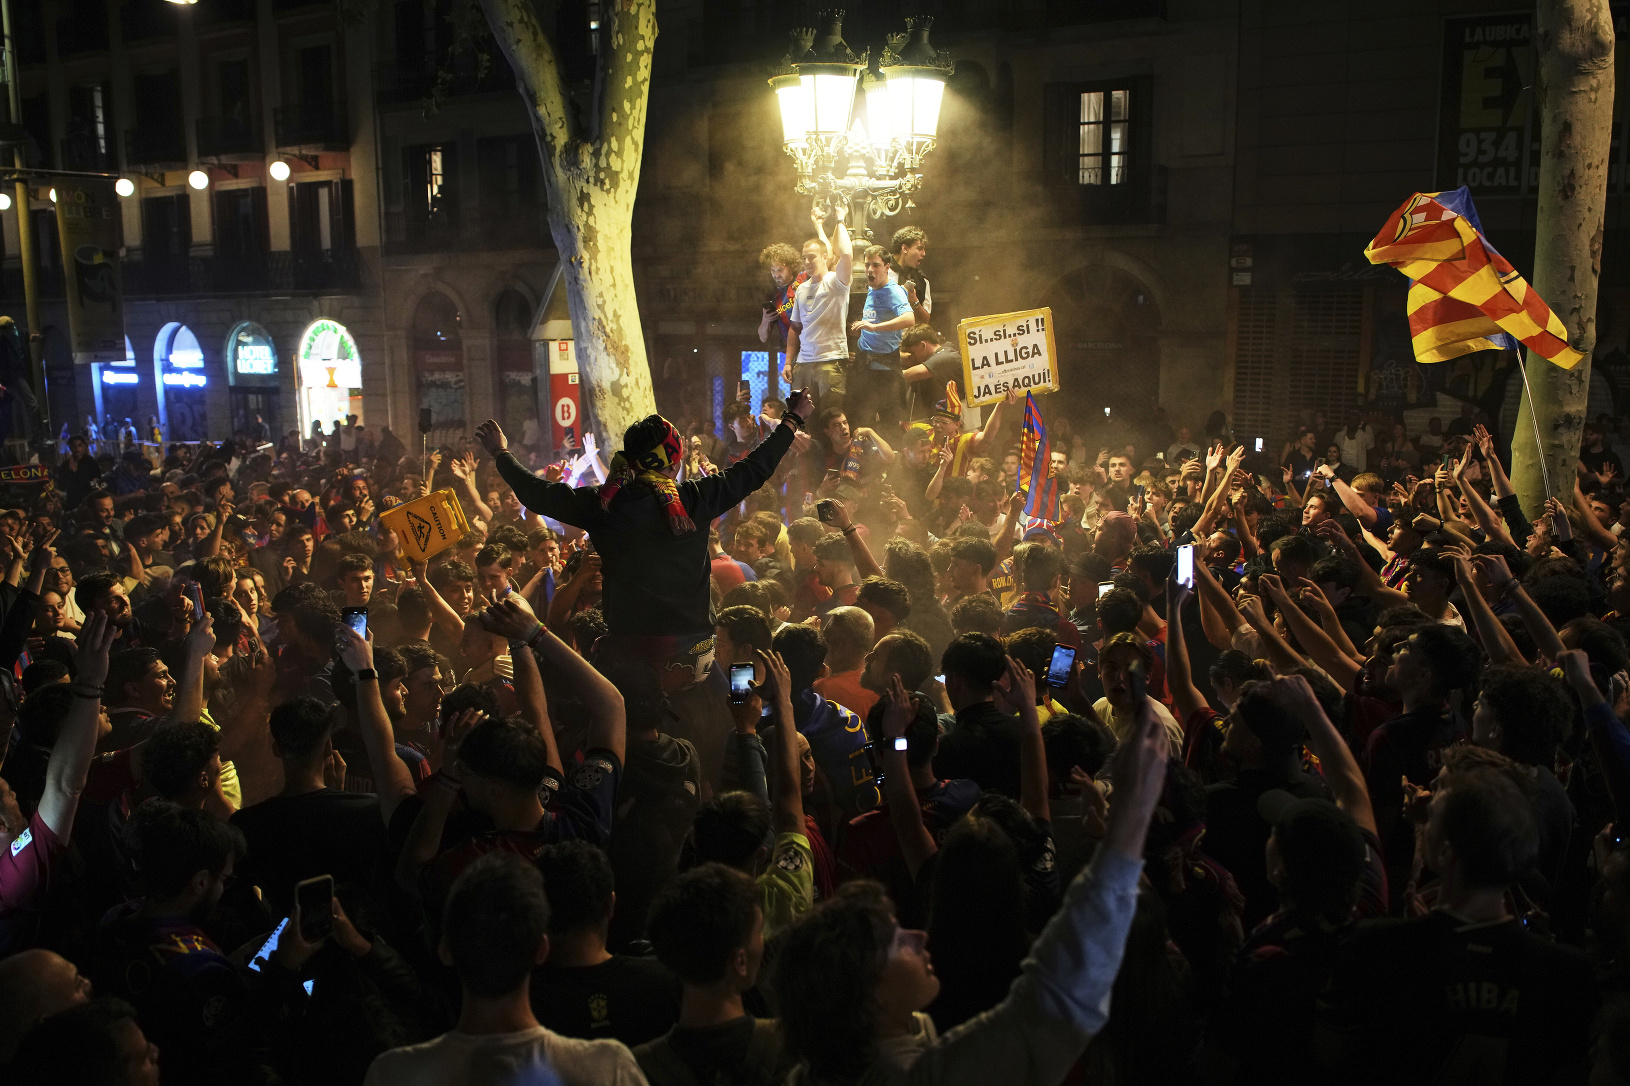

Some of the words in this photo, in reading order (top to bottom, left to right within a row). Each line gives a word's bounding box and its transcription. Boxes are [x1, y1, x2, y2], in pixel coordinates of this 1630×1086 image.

[1457, 165, 1519, 187] LOCAL
[238, 345, 271, 360] HOTEL
[970, 355, 992, 371] LA
[994, 343, 1042, 367] LLIGA
[973, 383, 993, 399] JA
[429, 505, 447, 541] CAUTION
